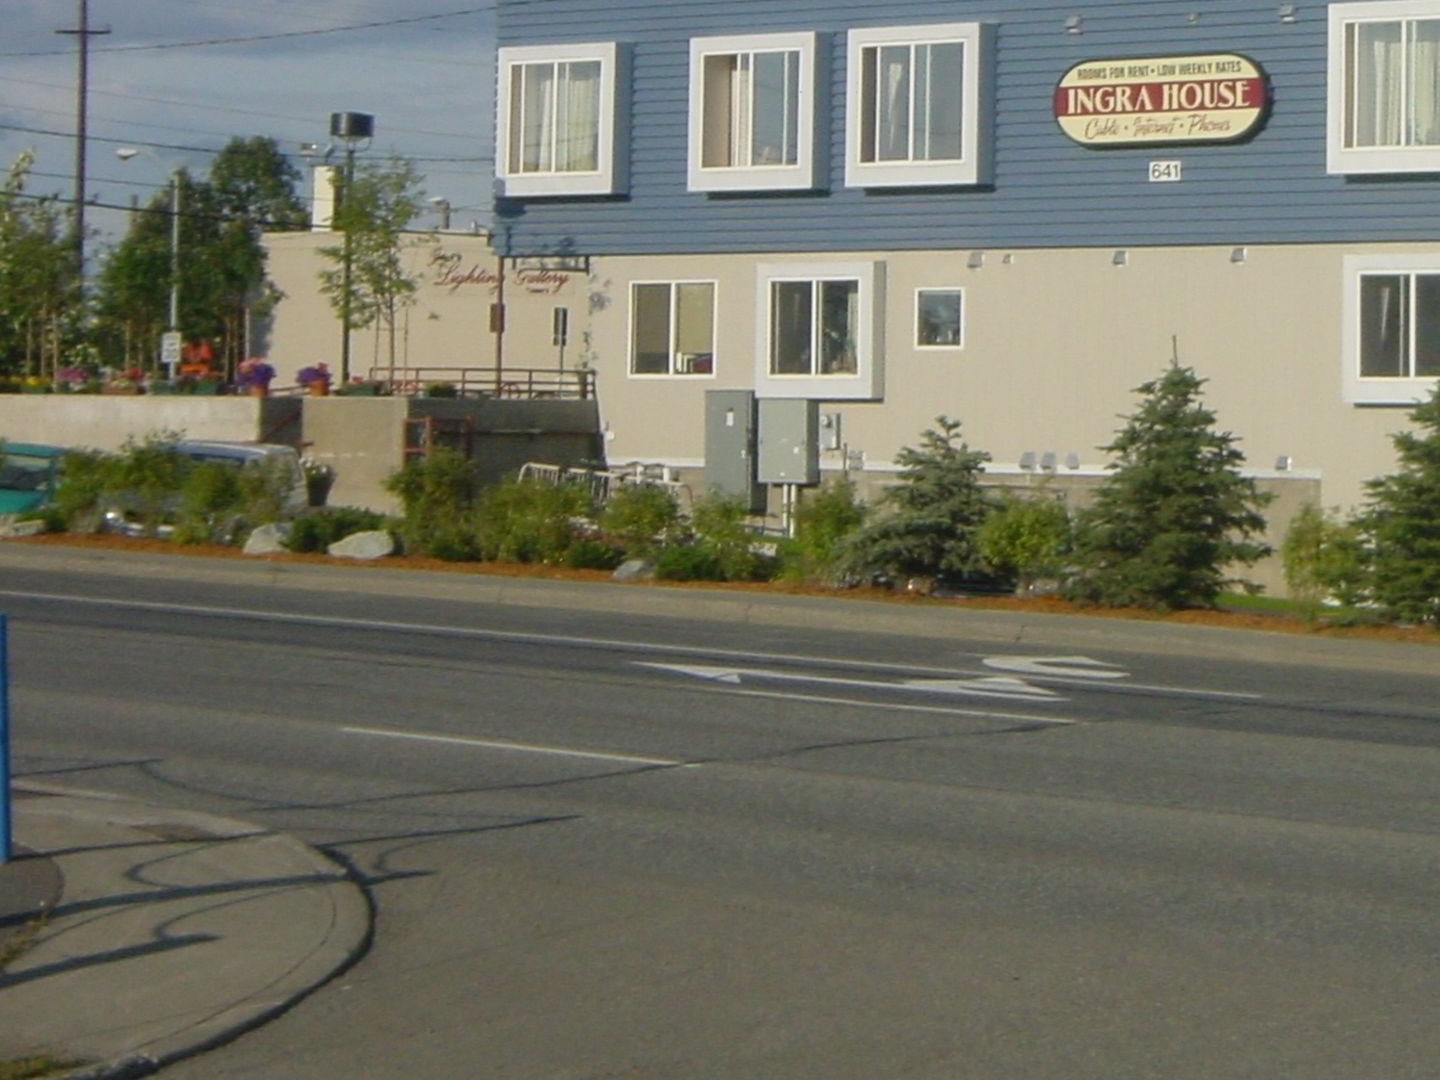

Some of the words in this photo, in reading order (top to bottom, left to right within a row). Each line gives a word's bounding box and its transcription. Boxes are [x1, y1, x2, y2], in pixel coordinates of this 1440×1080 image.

[1077, 67, 1107, 80] ROOMS
[1109, 66, 1125, 79] FOR
[1127, 65, 1149, 78] RENT
[1157, 63, 1176, 76] LOW
[1178, 62, 1213, 75] WEEKLY
[1216, 61, 1242, 74] RATES
[1067, 85, 1154, 114] INGRA
[1162, 80, 1251, 110] HOUSE
[1084, 117, 1120, 139] Cable
[1151, 164, 1179, 179] 641
